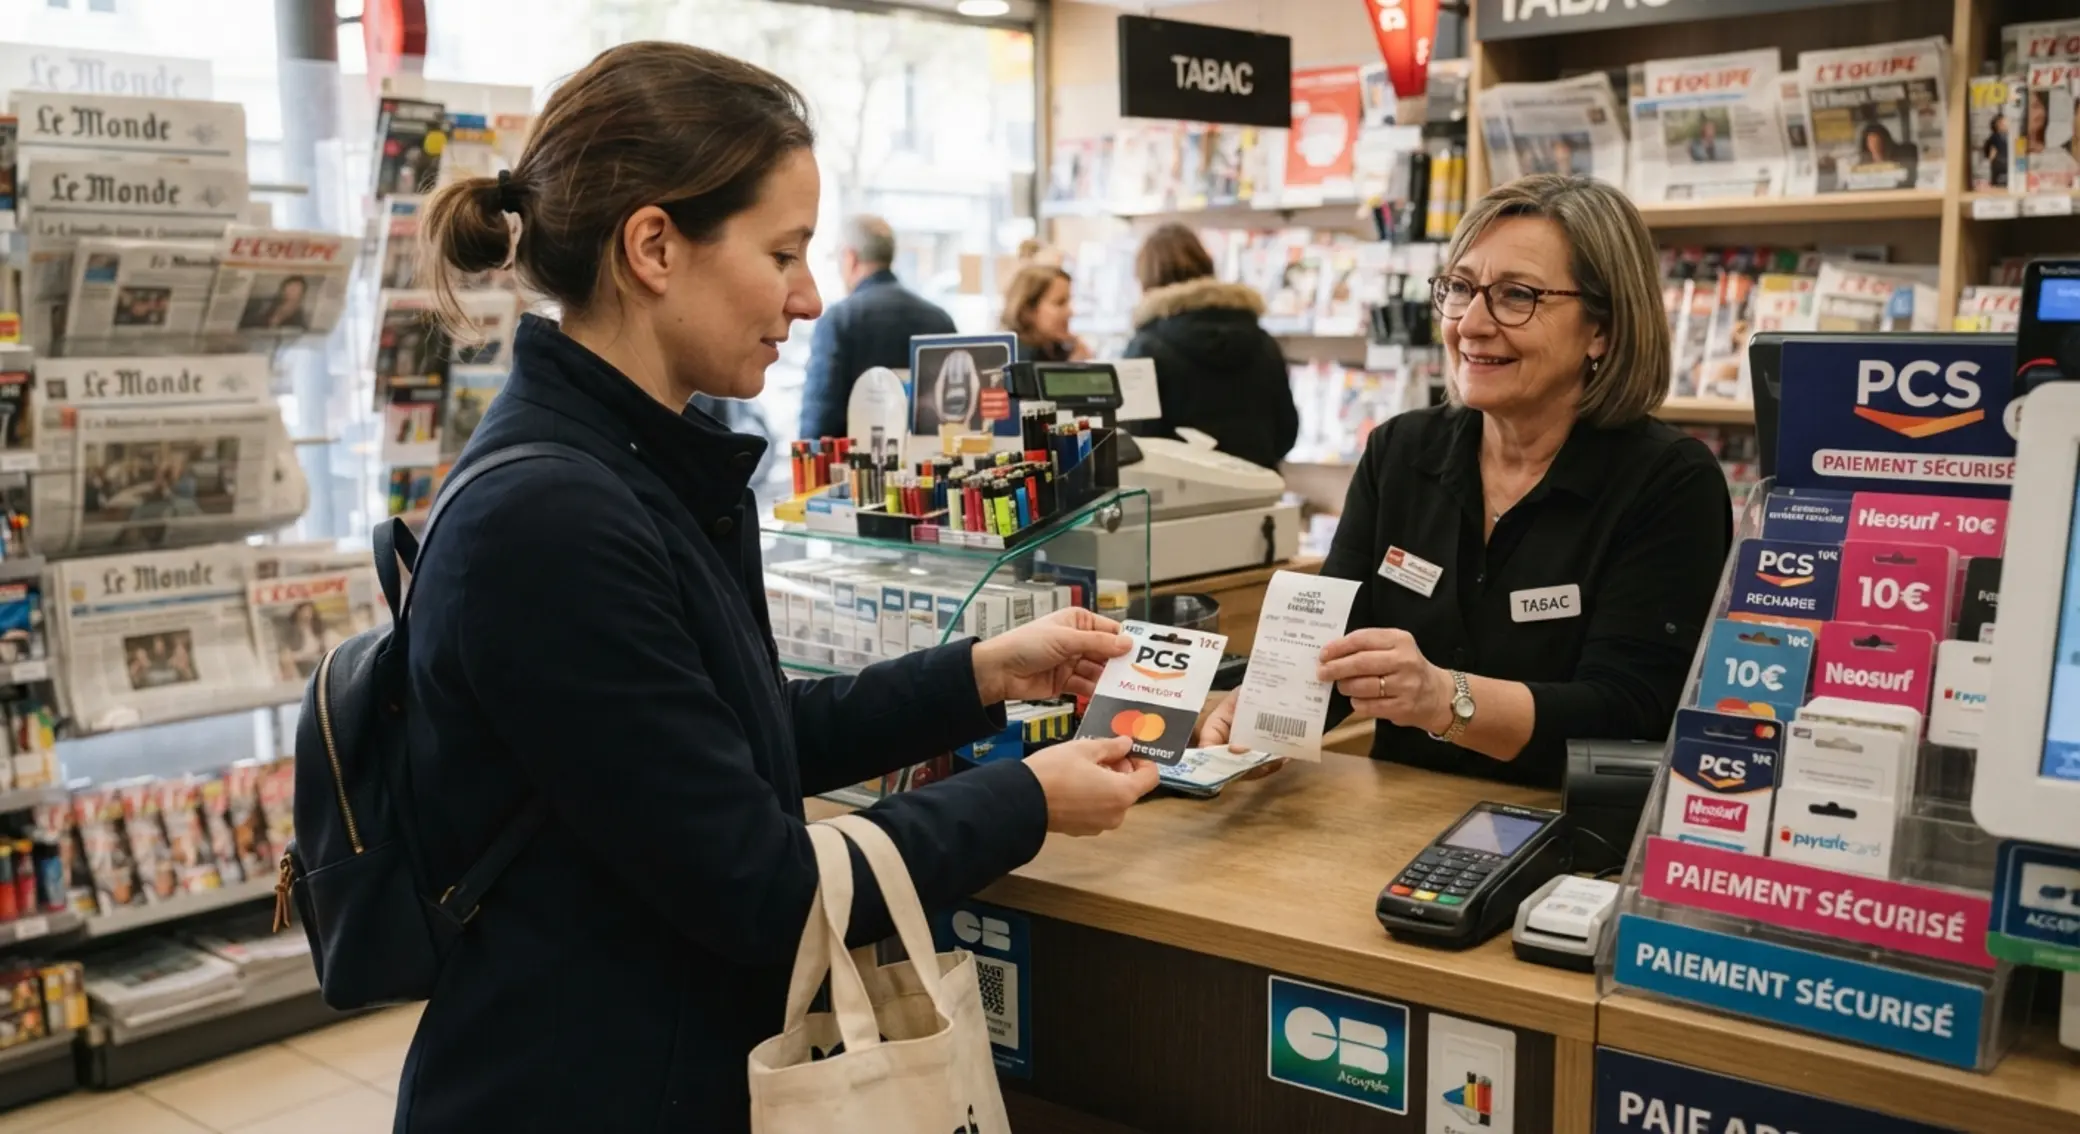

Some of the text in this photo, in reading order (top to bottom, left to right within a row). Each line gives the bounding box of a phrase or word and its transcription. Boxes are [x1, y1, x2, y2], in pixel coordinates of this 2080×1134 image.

[1171, 54, 1254, 96] TABAC
[36, 105, 172, 142] Le Monde
[51, 173, 181, 206] Le Monde
[83, 368, 203, 397] Le Monde
[1856, 359, 1982, 409] PCS
[1822, 454, 1918, 476] PAIEMENT
[1858, 507, 1940, 531] Neosurf
[1956, 514, 1997, 535] 10€
[102, 562, 215, 595] Le Monde
[1757, 549, 1814, 576] PCS
[1858, 575, 1931, 612] 10€
[1135, 645, 1190, 671] PCS
[1724, 657, 1788, 692] 10€
[1824, 661, 1915, 693] Neosurf
[1698, 753, 1747, 779] PCS
[1665, 860, 1967, 943] PAIEMENT SÉCURISÉ
[1635, 942, 1955, 1038] PAIEMENT SÉCURISÉ
